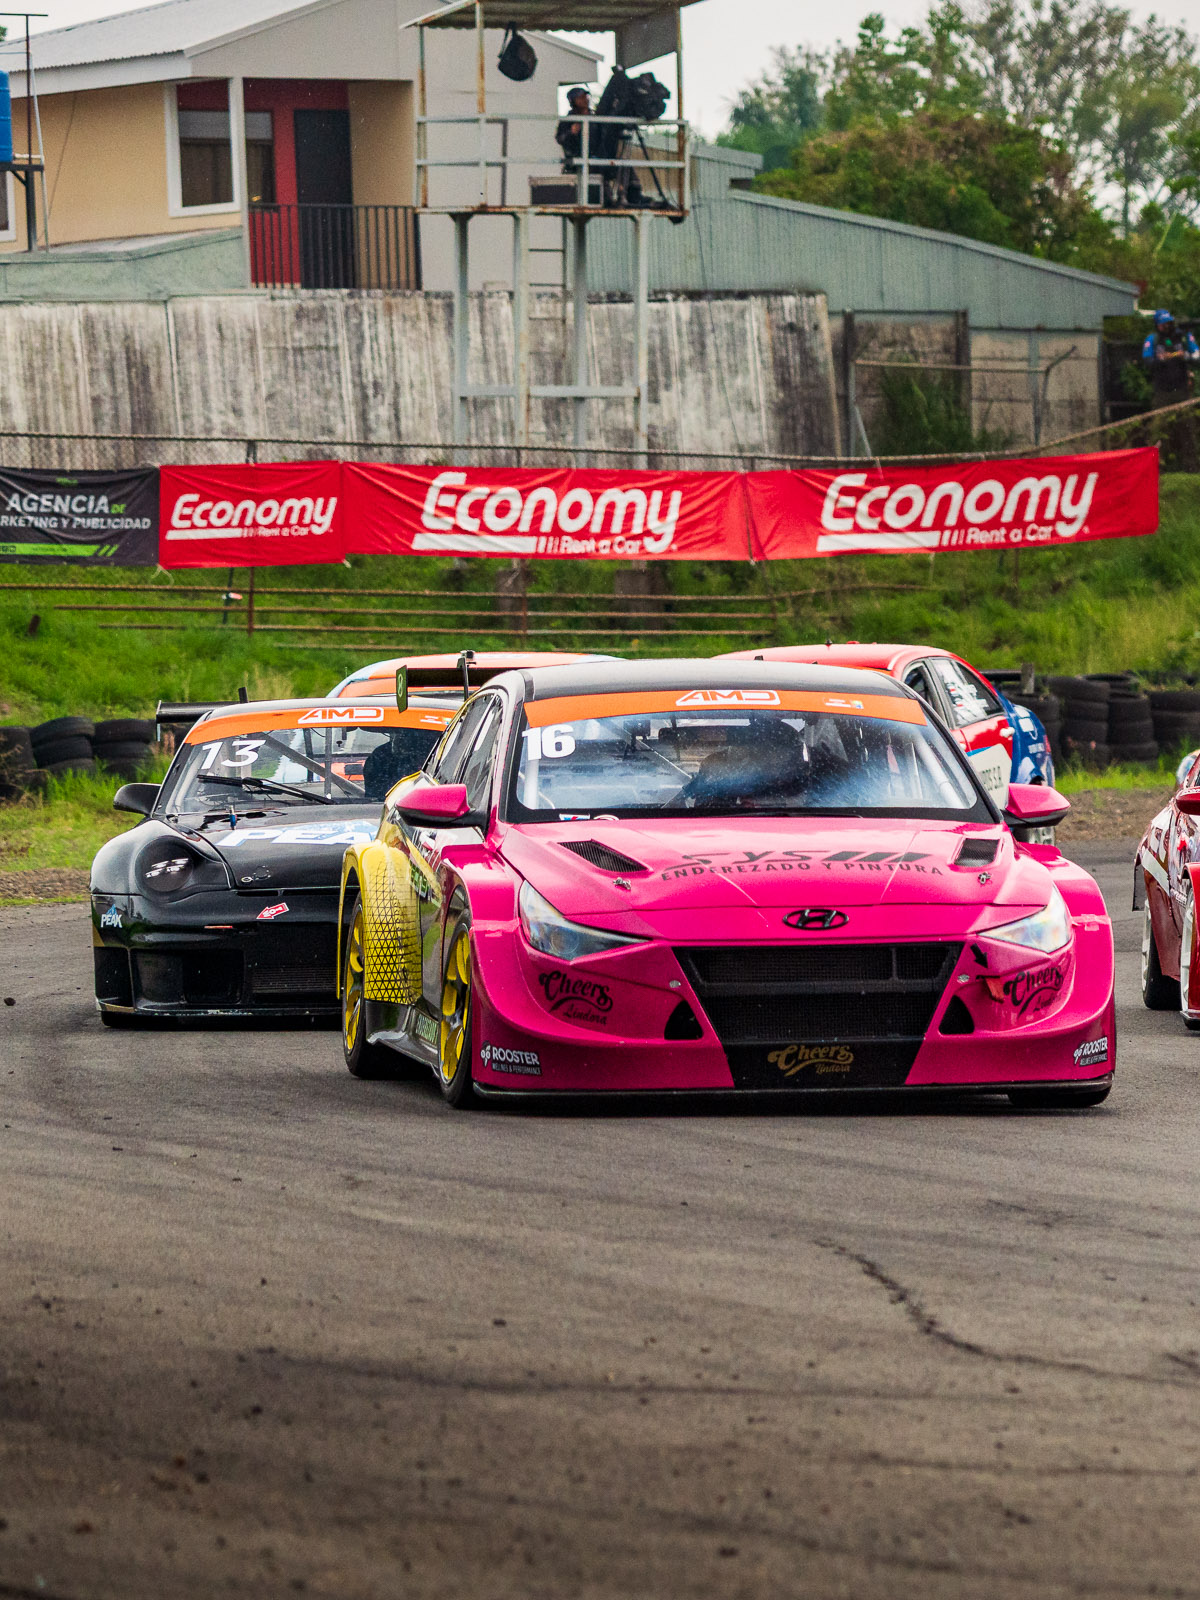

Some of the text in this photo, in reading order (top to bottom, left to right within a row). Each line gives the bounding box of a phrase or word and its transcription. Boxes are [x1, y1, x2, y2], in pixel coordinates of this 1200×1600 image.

[6, 493, 110, 514] AGENCIA
[171, 493, 338, 535] Economy
[420, 472, 683, 553] Economy
[820, 472, 1099, 537] Economy
[0, 515, 152, 530] RKETING Y PUBLICIDAD
[966, 523, 1055, 545] Rent a Car
[561, 536, 645, 554] Rent a Car
[678, 690, 779, 705] AMD
[300, 707, 383, 722] AMD
[522, 724, 576, 761] 16
[202, 739, 267, 770] 13
[216, 828, 376, 847] PEA
[662, 862, 811, 881] ENDEREZADO
[844, 863, 943, 876] PINTURA
[101, 913, 122, 928] PEAK
[538, 970, 613, 1008] Cheers
[1003, 967, 1064, 1007] Cheers
[563, 1003, 608, 1025] Lindora
[492, 1046, 540, 1065] ROOSTER
[1082, 1036, 1108, 1056] ROOSTER
[767, 1044, 854, 1071] Cheers
